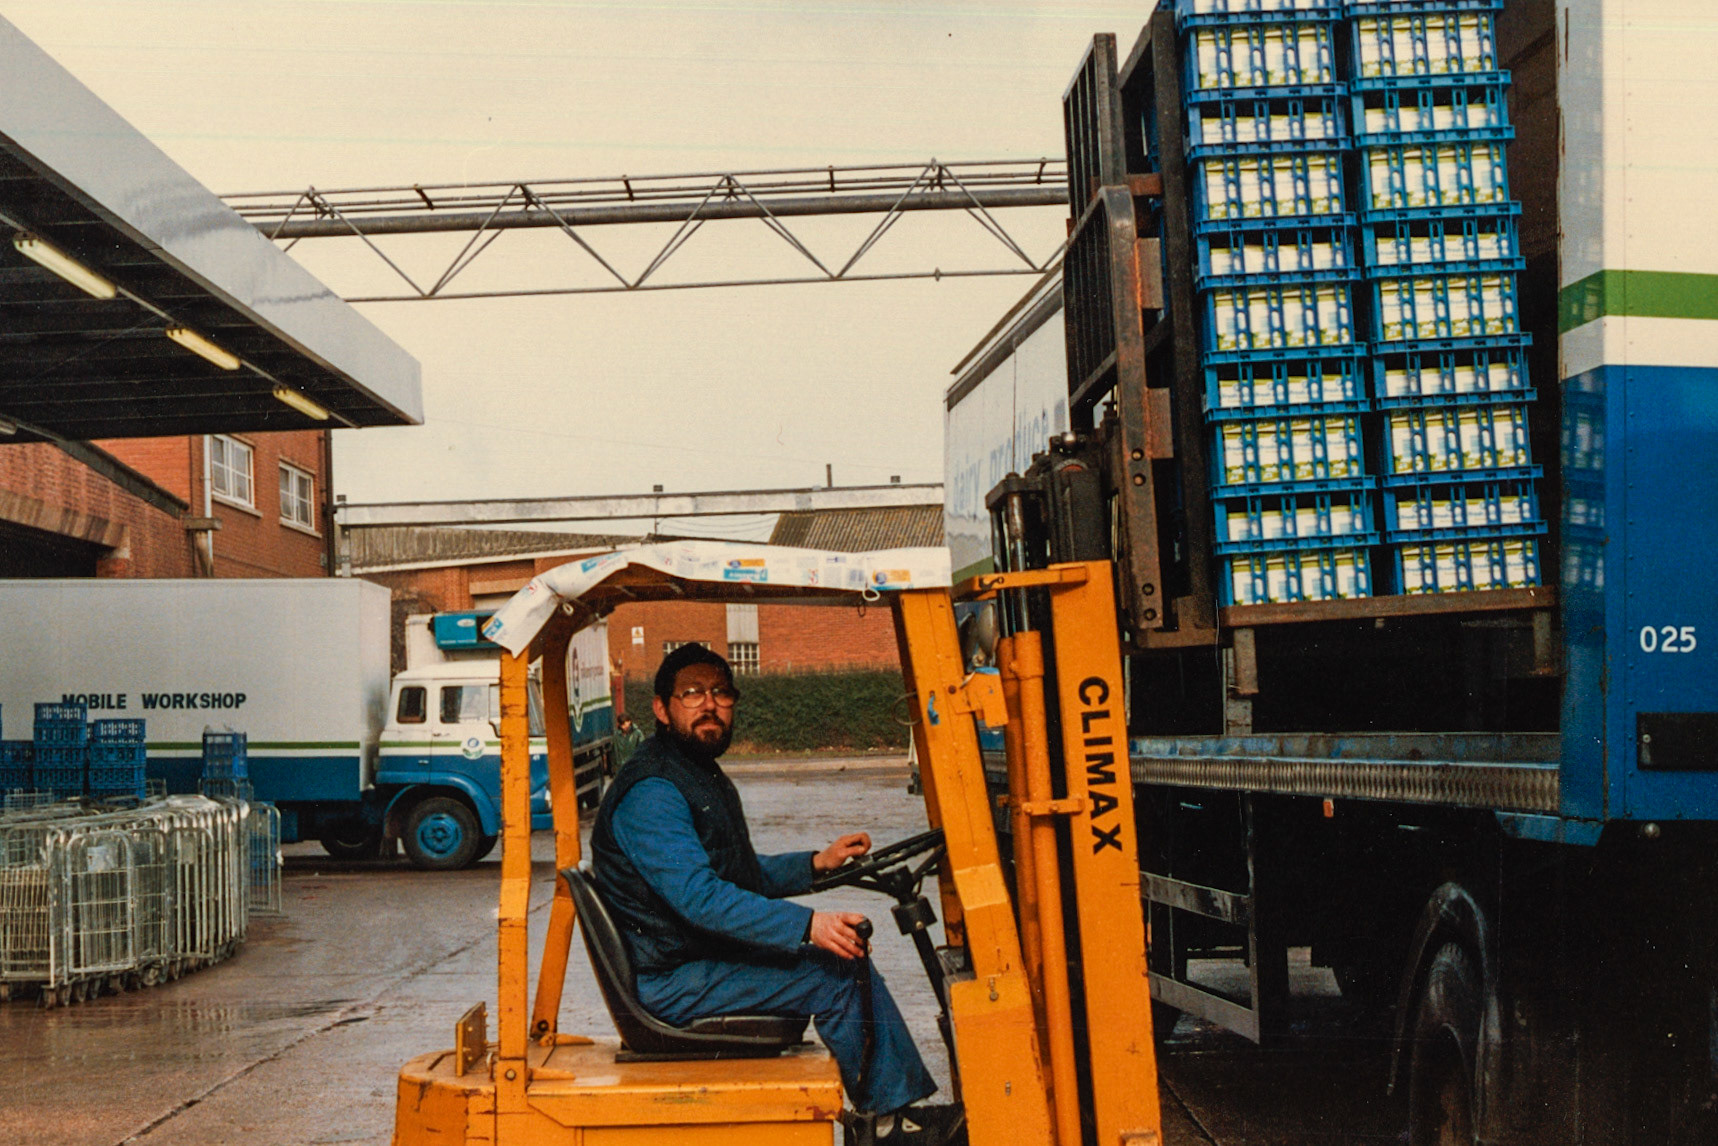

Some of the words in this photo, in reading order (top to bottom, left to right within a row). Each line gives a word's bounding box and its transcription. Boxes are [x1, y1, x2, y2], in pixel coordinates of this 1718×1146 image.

[1640, 625, 1697, 653] 025
[62, 693, 127, 710] MOBILE
[141, 692, 247, 710] WORKSHOP
[1078, 676, 1123, 855] CLIMAX
